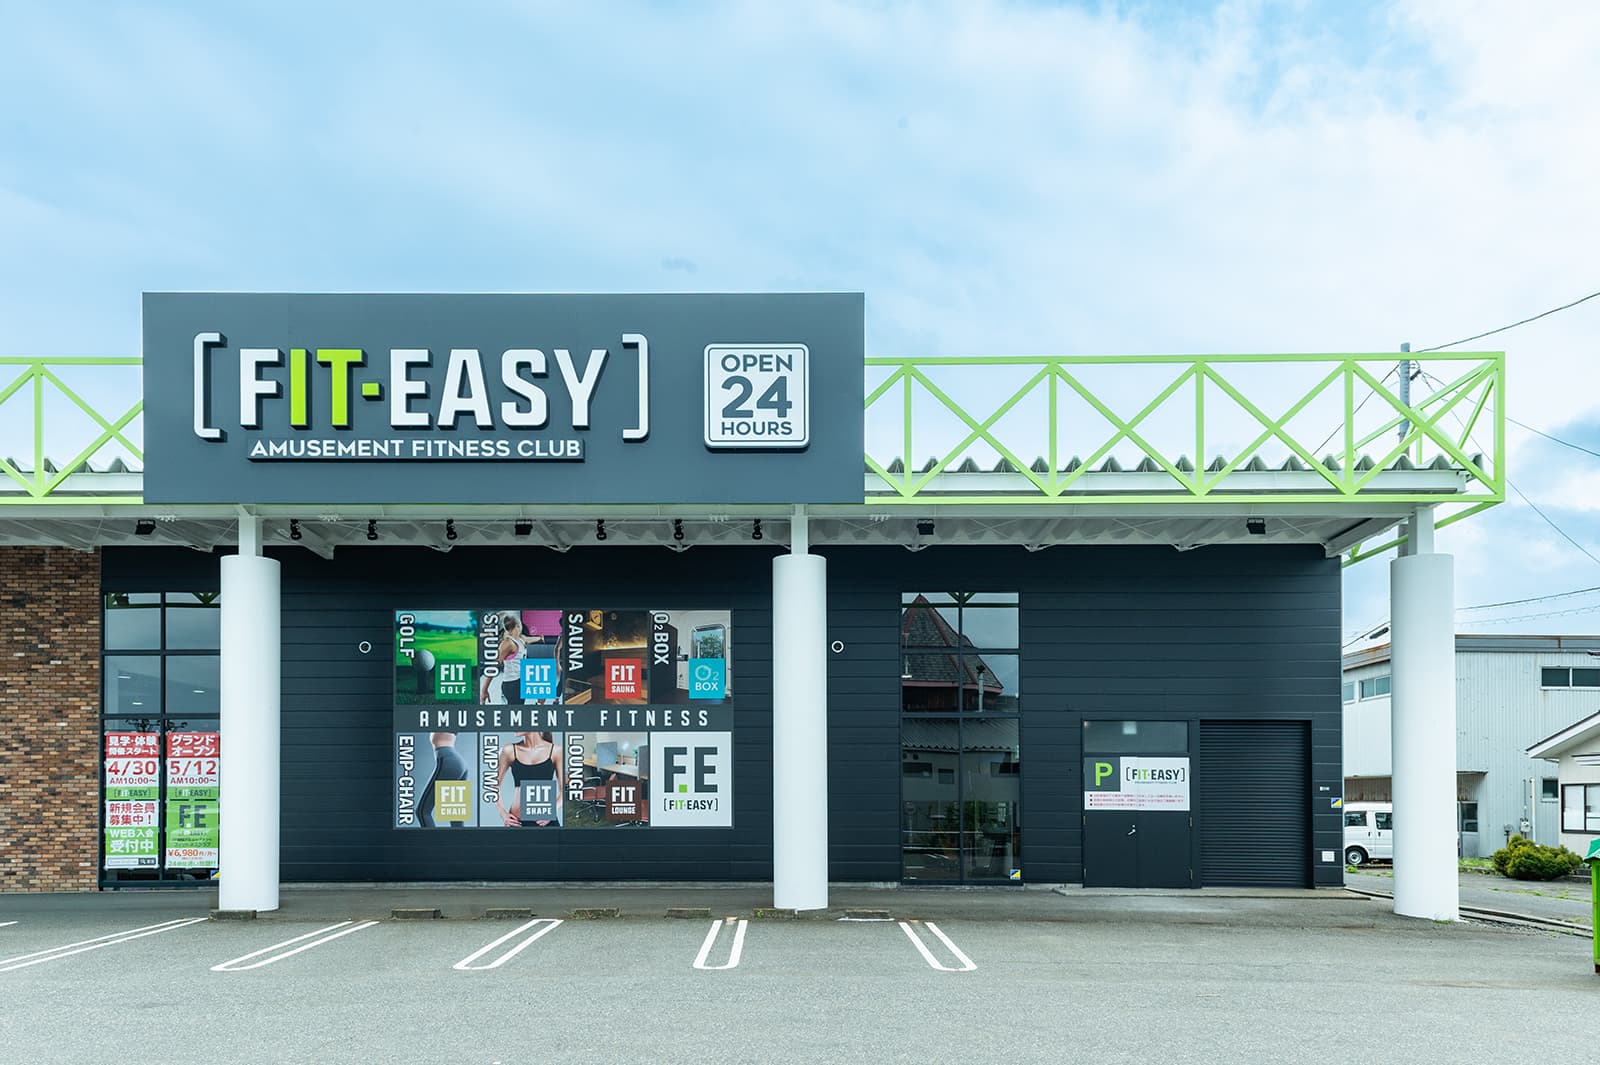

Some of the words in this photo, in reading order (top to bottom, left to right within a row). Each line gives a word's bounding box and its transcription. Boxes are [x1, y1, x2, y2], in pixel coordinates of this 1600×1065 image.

[720, 354, 793, 373] OPEN
[721, 375, 793, 419] 24
[721, 421, 793, 436] HOURS
[250, 439, 404, 457] AMUSEMENT
[412, 439, 511, 457] FITNESS
[517, 439, 581, 457] CLUB
[399, 614, 415, 659] GOLF
[568, 613, 584, 672] SAUNA
[483, 614, 499, 678] STUDIO
[440, 664, 466, 681] FIT
[525, 664, 551, 682] FIT
[611, 665, 636, 682] FIT
[440, 686, 467, 694] GOLF
[525, 687, 551, 695] AERO
[611, 685, 636, 693] SAUNA
[694, 682, 719, 691] BOX
[419, 710, 575, 727] AMUSEMENT
[600, 710, 708, 727] FITNESS
[171, 734, 216, 746] グランド
[171, 746, 216, 757] オープン
[108, 760, 157, 776] 4/30
[170, 760, 217, 776] 5/12
[568, 735, 584, 801] LOUNGE
[1095, 762, 1113, 787] P
[398, 735, 415, 825] EMP-CHAIR
[440, 786, 467, 803] FIT
[525, 786, 552, 803] FIT
[611, 786, 636, 803] FIT
[109, 802, 155, 814] 新規会員
[440, 807, 467, 816] CHAIR
[525, 807, 552, 815] SHAPE
[611, 806, 636, 815] LOUNGE
[110, 840, 155, 853] 受付中
